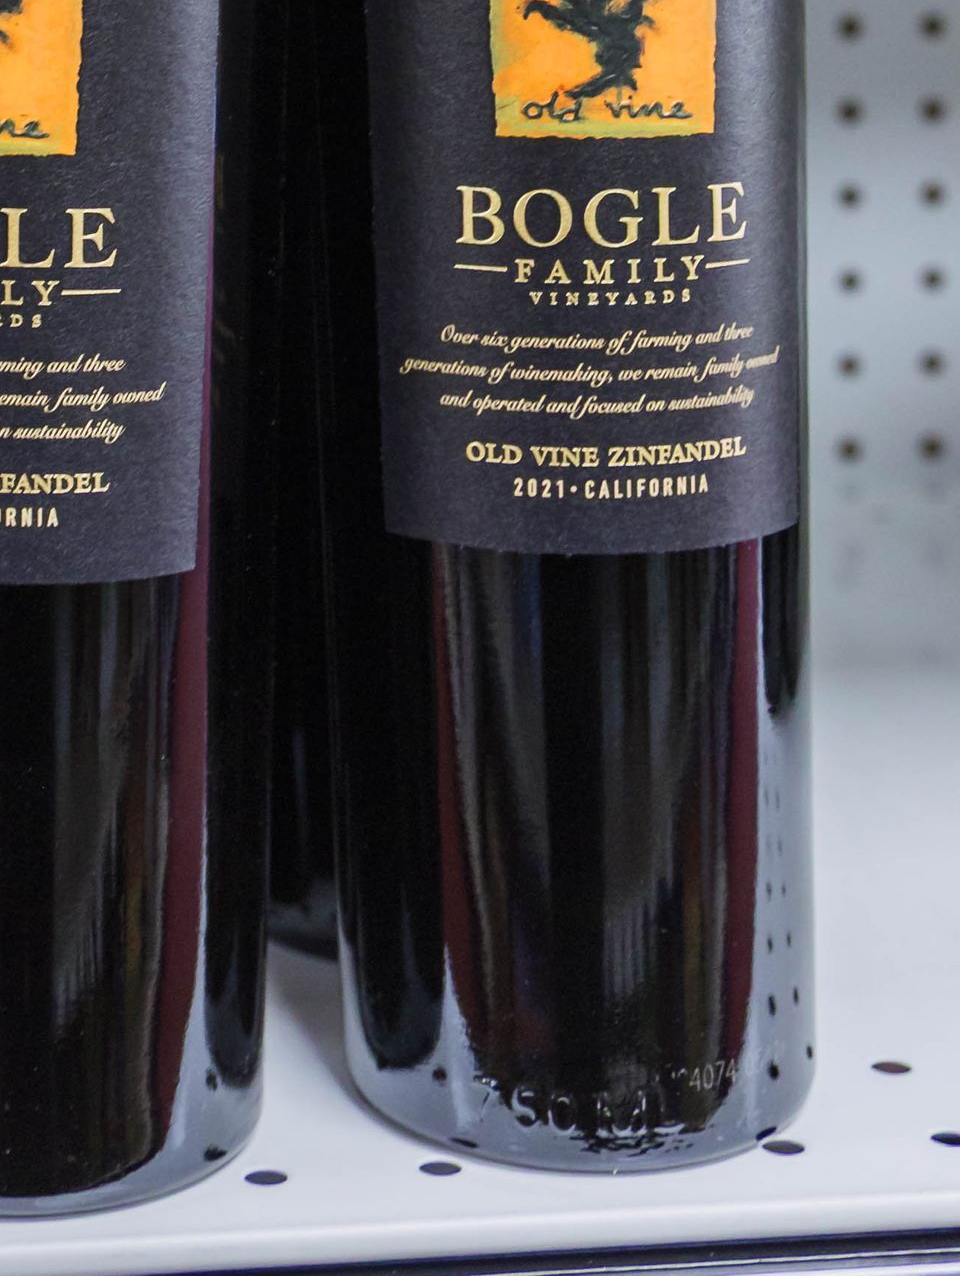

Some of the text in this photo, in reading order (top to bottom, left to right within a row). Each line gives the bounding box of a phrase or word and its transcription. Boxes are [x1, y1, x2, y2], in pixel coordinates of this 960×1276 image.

[521, 96, 693, 122] old vine
[455, 181, 748, 248] BOGLE
[514, 254, 706, 285] FAMILY
[529, 288, 692, 306] VINEYARDS
[440, 321, 754, 356] Over six generations of farming and three
[46, 353, 85, 373] and
[83, 353, 127, 372] three
[399, 357, 489, 377] generations
[487, 361, 515, 385] of
[510, 362, 613, 389] winemaking,
[617, 367, 644, 382] we
[644, 361, 700, 381] remain
[693, 353, 745, 384] family
[43, 386, 111, 414] family
[112, 381, 167, 404] owned
[440, 384, 755, 420] and operated and focused on sustainability
[13, 418, 126, 445] sustainability
[465, 435, 747, 468] OLD VINE ZINFANDEL
